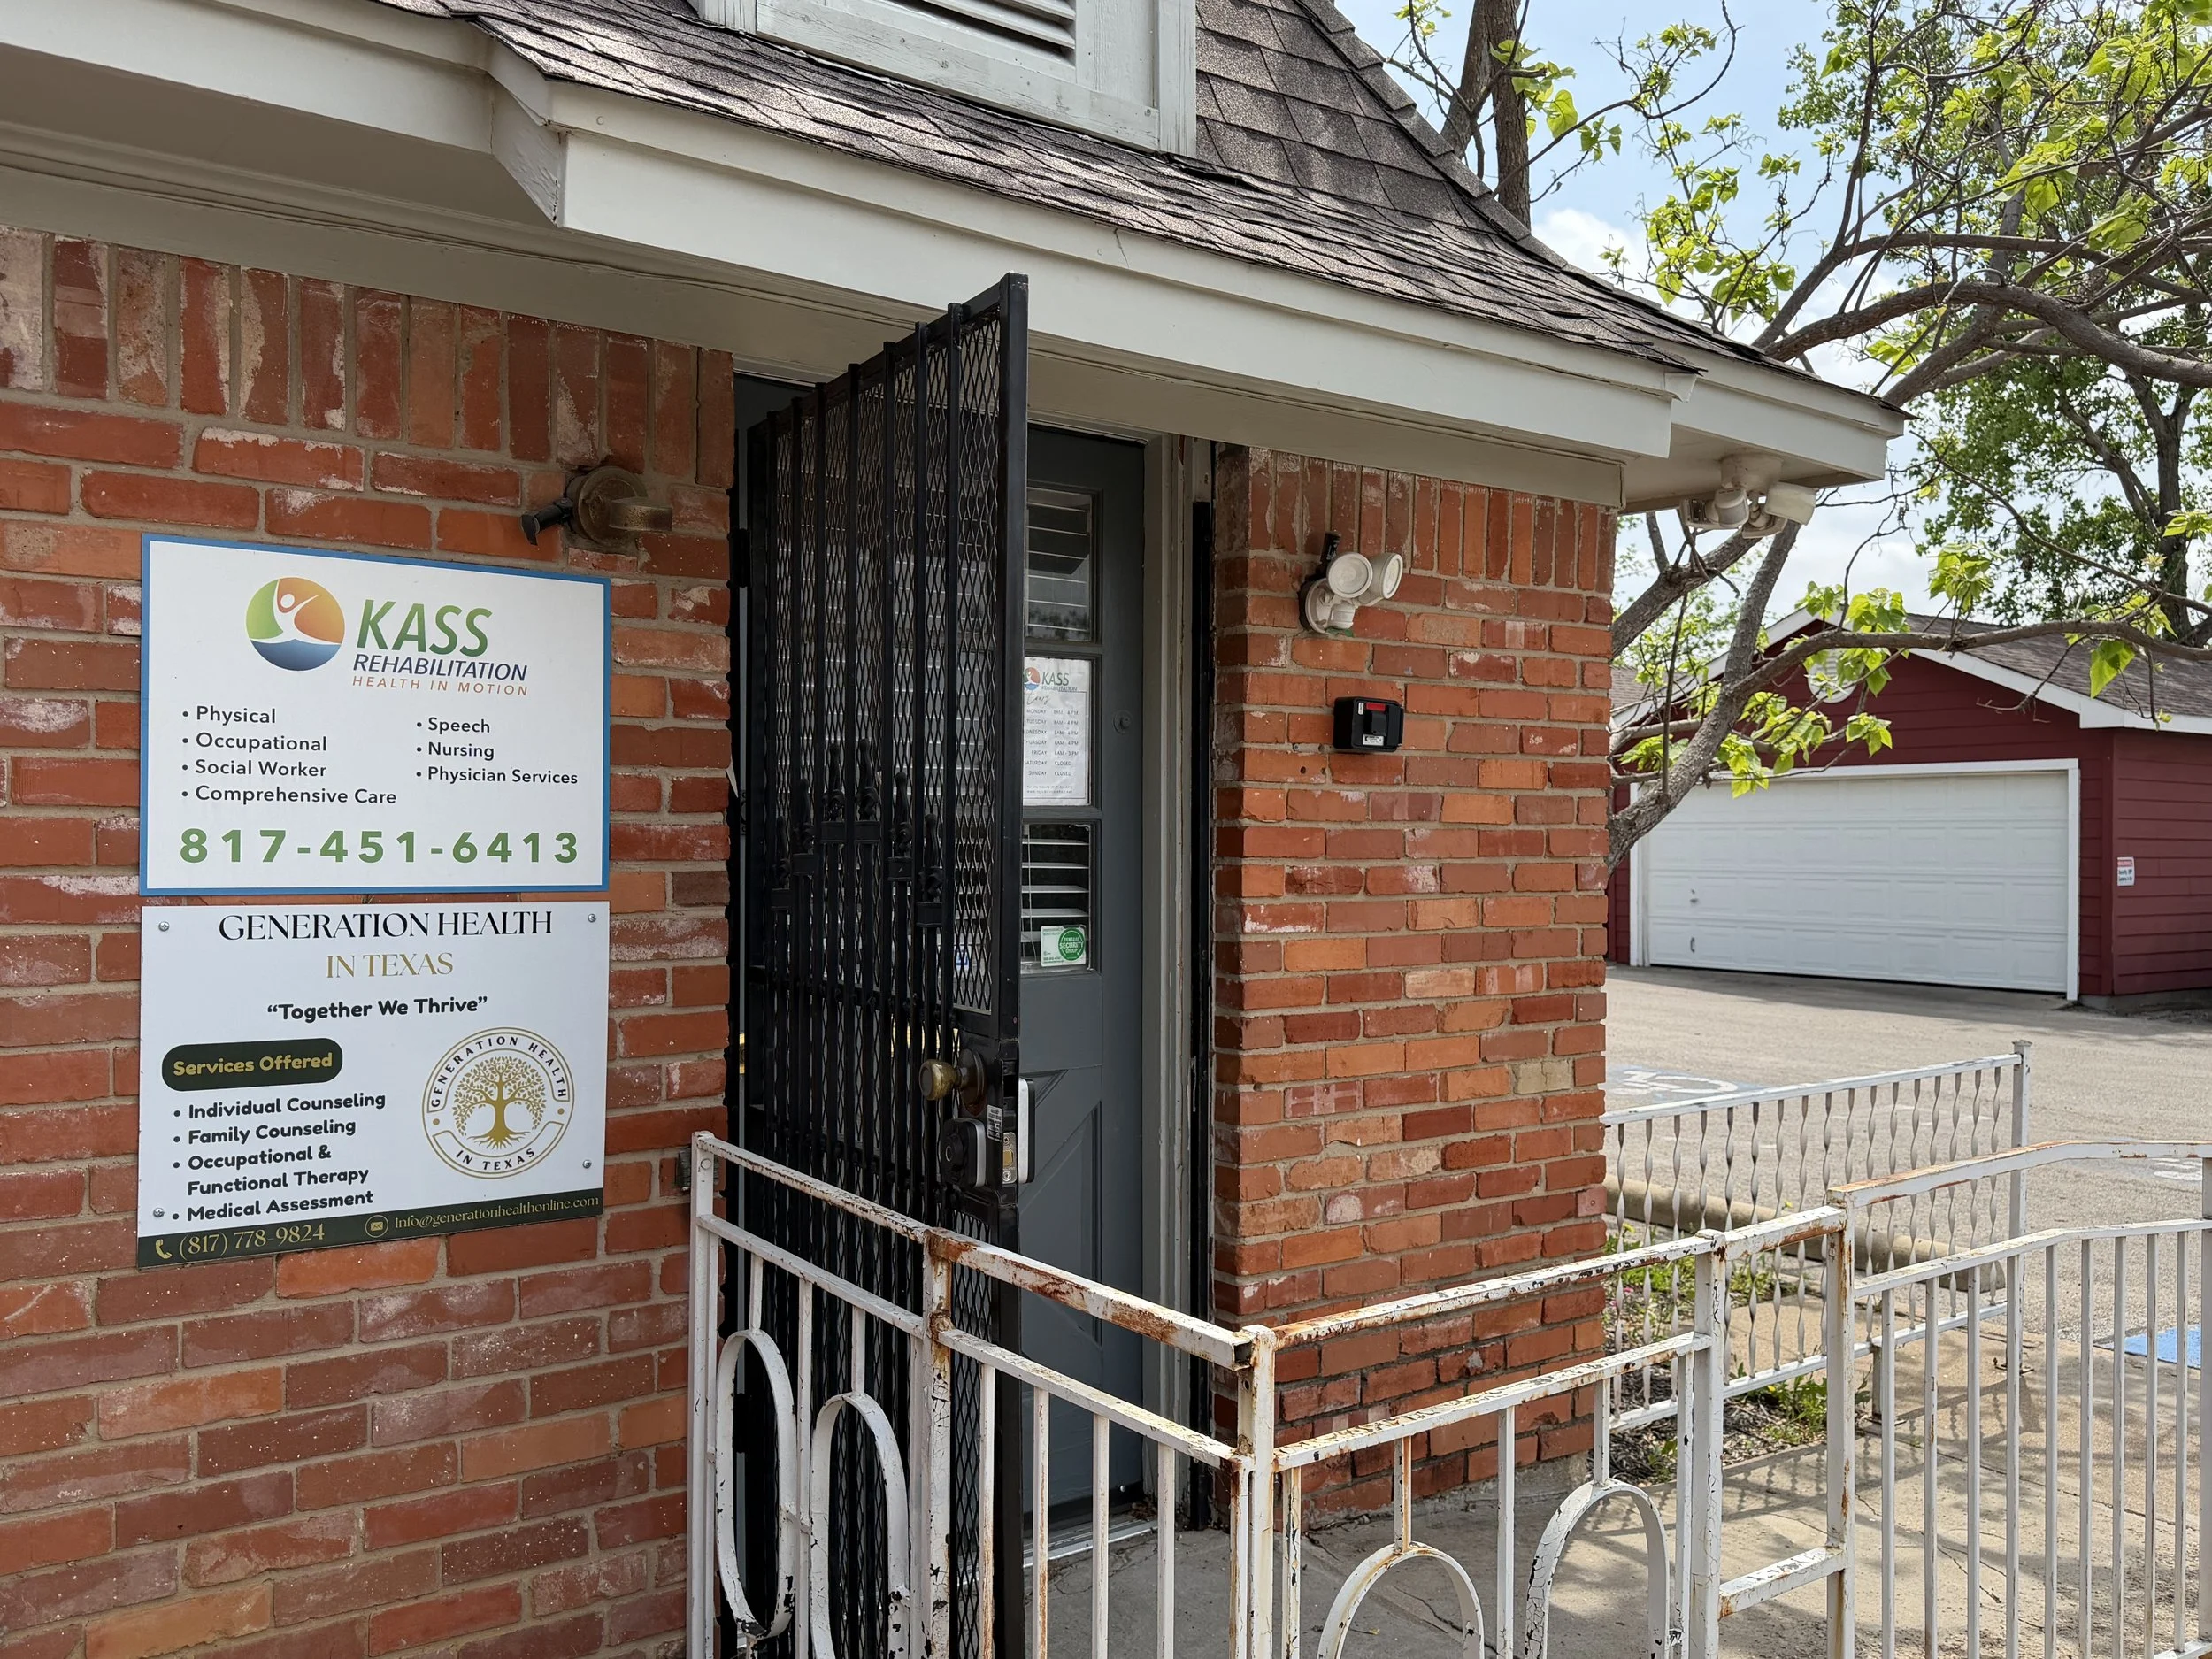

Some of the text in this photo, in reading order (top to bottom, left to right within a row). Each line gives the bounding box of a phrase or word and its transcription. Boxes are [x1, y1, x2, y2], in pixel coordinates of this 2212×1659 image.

[357, 599, 493, 657] KASS
[353, 654, 528, 681] REHABILITATION
[1042, 672, 1069, 686] KASS
[352, 676, 529, 696] HEALTH IN MOTION
[197, 705, 275, 726] Physical
[428, 718, 489, 734] Speech
[196, 733, 326, 753] Occupational
[429, 742, 494, 761] Nursing
[196, 759, 326, 776] Social Worker
[428, 766, 577, 784] Physician Services
[196, 786, 396, 805] Comprehensive Care
[180, 828, 577, 863] 817-451-6413
[219, 911, 551, 940] GENERATION HEALTH
[327, 952, 453, 978] IN TEXAS
[268, 996, 487, 1023] “Together We Thrive”
[173, 1053, 333, 1077] Services Offered
[431, 1036, 566, 1108] GENERATION HEALTH
[189, 1093, 385, 1118] Individual Counseling
[189, 1119, 356, 1144] Family Counseling
[188, 1145, 331, 1171] Occupational &
[456, 1148, 535, 1171] IN TEXAS
[188, 1170, 370, 1195] Functional Therapy
[188, 1190, 374, 1221] Medical Assessment
[396, 1196, 599, 1228] Info@generationhealthonline.com
[180, 1223, 325, 1261] (817) 778-9824
